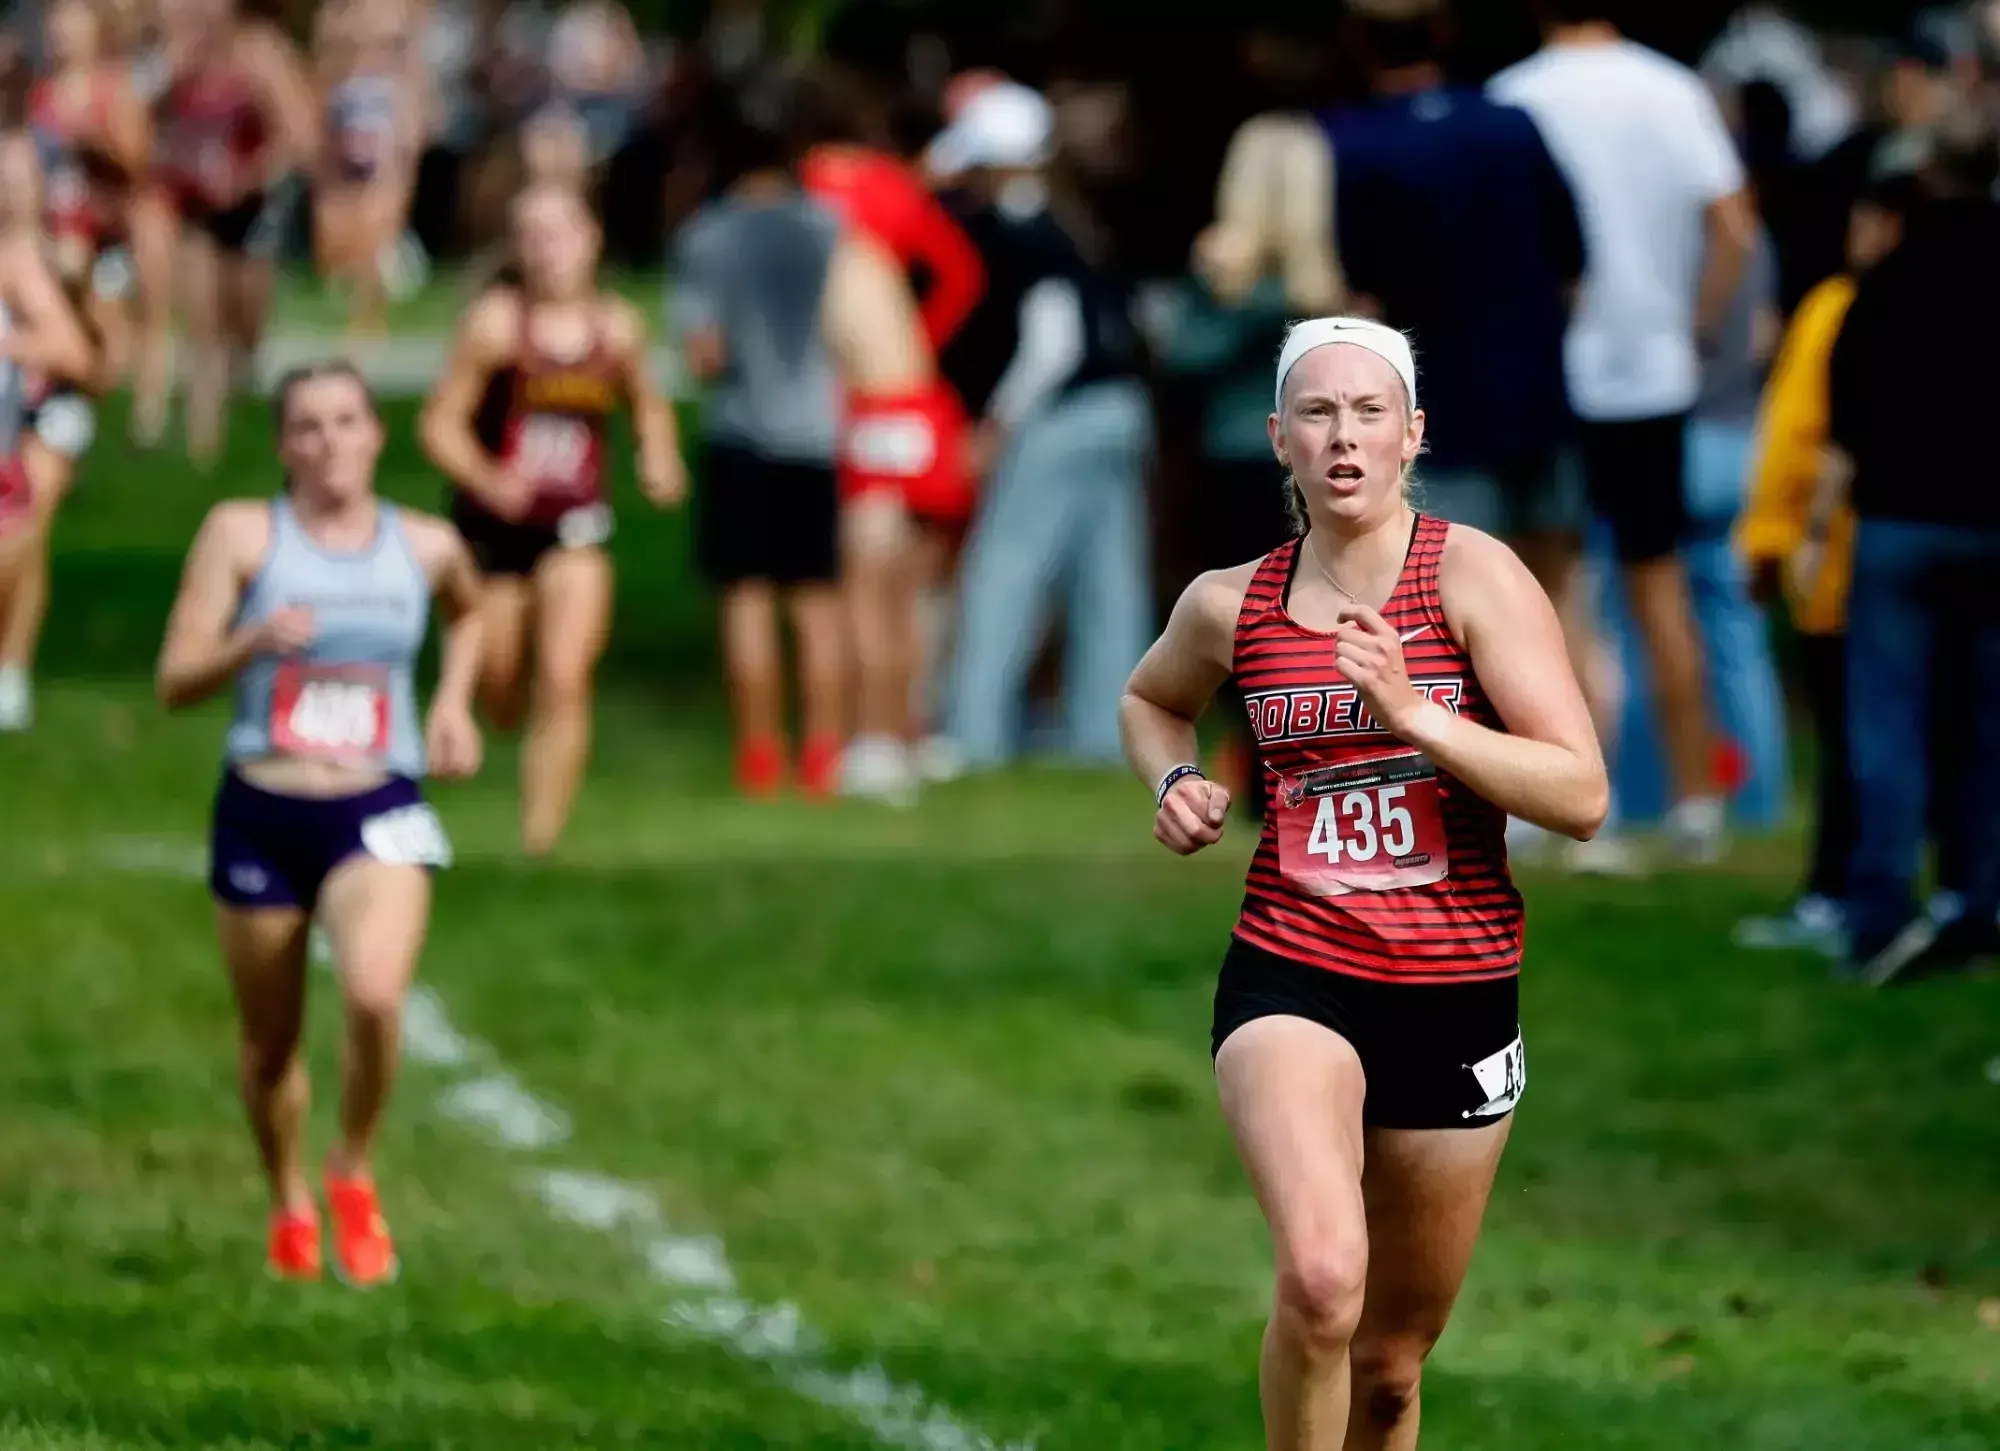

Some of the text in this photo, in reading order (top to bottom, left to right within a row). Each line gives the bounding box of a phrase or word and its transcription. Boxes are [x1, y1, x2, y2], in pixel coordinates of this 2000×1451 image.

[1246, 683, 1461, 741] ROBES
[1307, 786, 1415, 865] 435
[1394, 854, 1429, 867] ROBERTS
